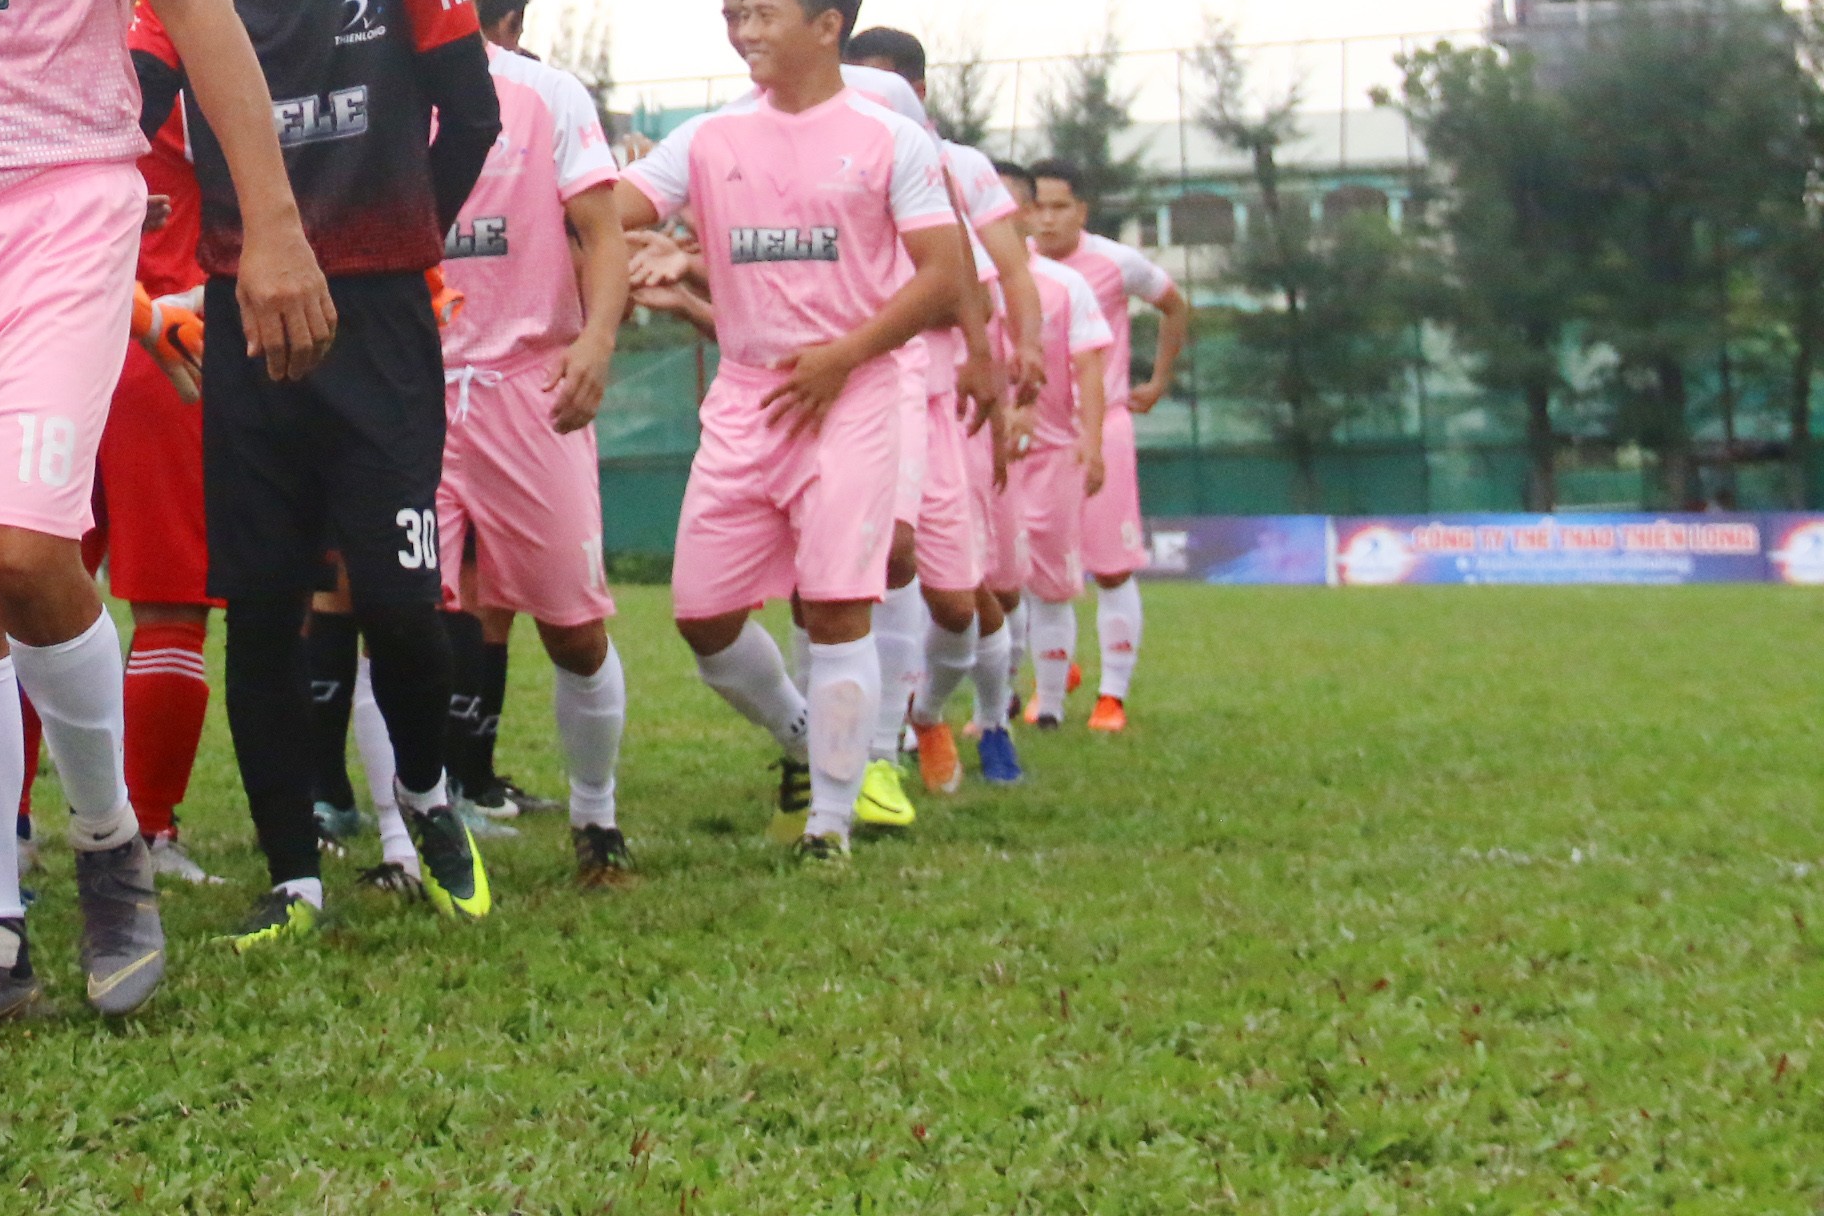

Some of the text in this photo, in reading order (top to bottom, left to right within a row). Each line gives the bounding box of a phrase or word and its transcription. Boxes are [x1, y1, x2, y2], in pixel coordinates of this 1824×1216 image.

[272, 85, 368, 148] ELE
[444, 216, 508, 260] LE
[729, 225, 840, 265] HELE
[18, 413, 76, 488] 18
[395, 508, 438, 570] 30
